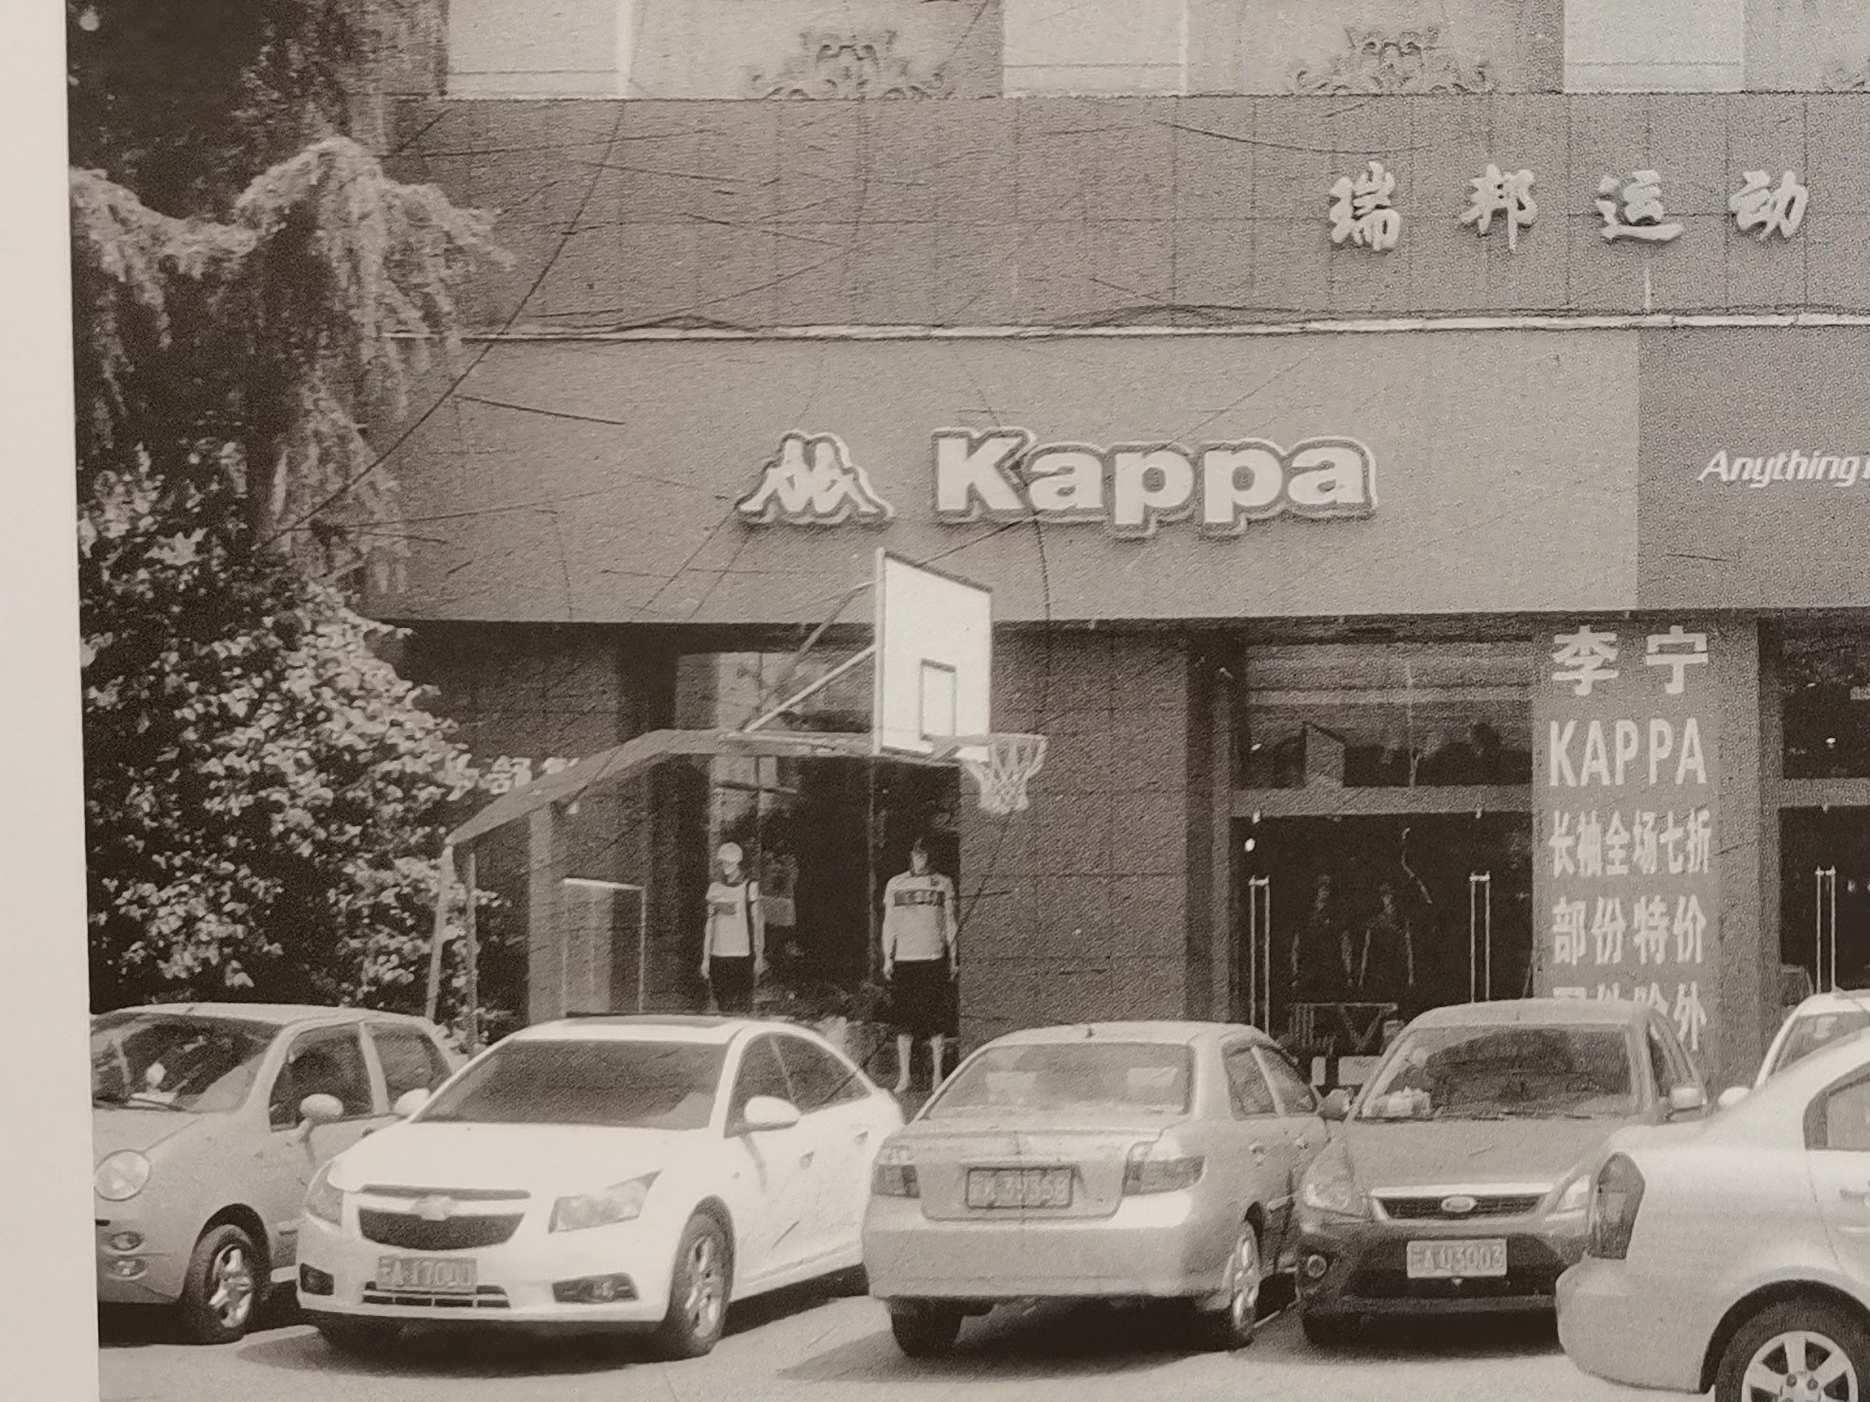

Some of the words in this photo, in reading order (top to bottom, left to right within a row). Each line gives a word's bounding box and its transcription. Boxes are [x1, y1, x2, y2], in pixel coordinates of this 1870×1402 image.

[1329, 160, 1809, 252] 瑞邦运动
[932, 427, 1376, 536] Kappa
[1697, 448, 1861, 488] Anything
[1551, 624, 1709, 696] 李宁
[1549, 717, 1707, 788] KAPPA
[1551, 894, 1707, 966] 部份特价
